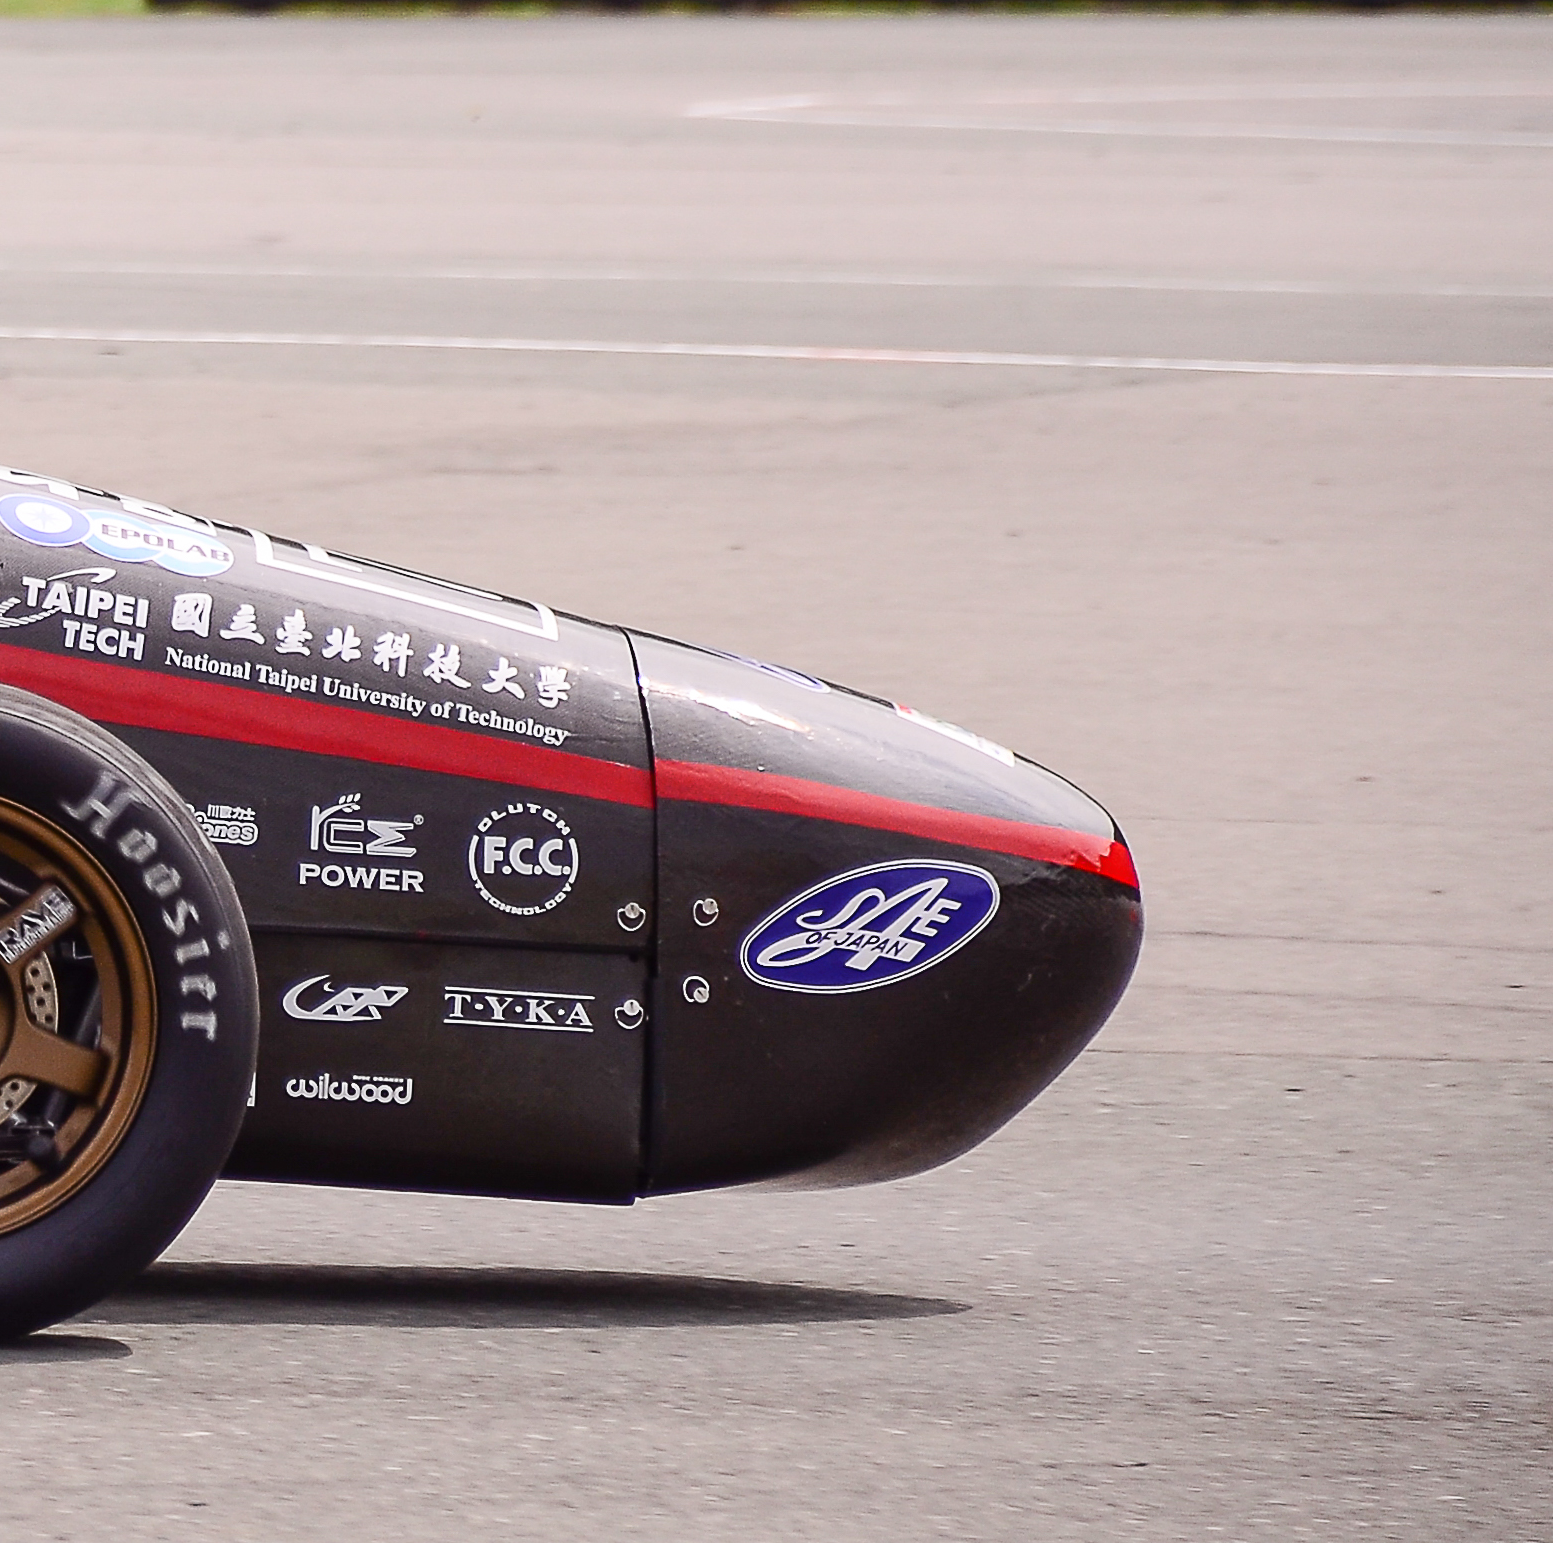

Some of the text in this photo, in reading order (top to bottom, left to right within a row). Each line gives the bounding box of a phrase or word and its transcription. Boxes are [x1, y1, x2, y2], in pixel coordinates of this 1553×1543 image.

[100, 523, 231, 563] EPOLAB
[22, 576, 150, 628] TAIPEI
[62, 619, 146, 661] TECH
[170, 591, 573, 710] 國立臺北科技大學
[164, 646, 571, 747] National Taipei University of Technology
[201, 821, 256, 841] ones
[483, 836, 572, 876] F.C.C.
[298, 862, 425, 893] POWER
[59, 769, 231, 1042] Hoosier
[756, 877, 963, 972] SAE
[805, 931, 909, 957] OF JAPAN
[285, 1072, 413, 1105] wilwood
